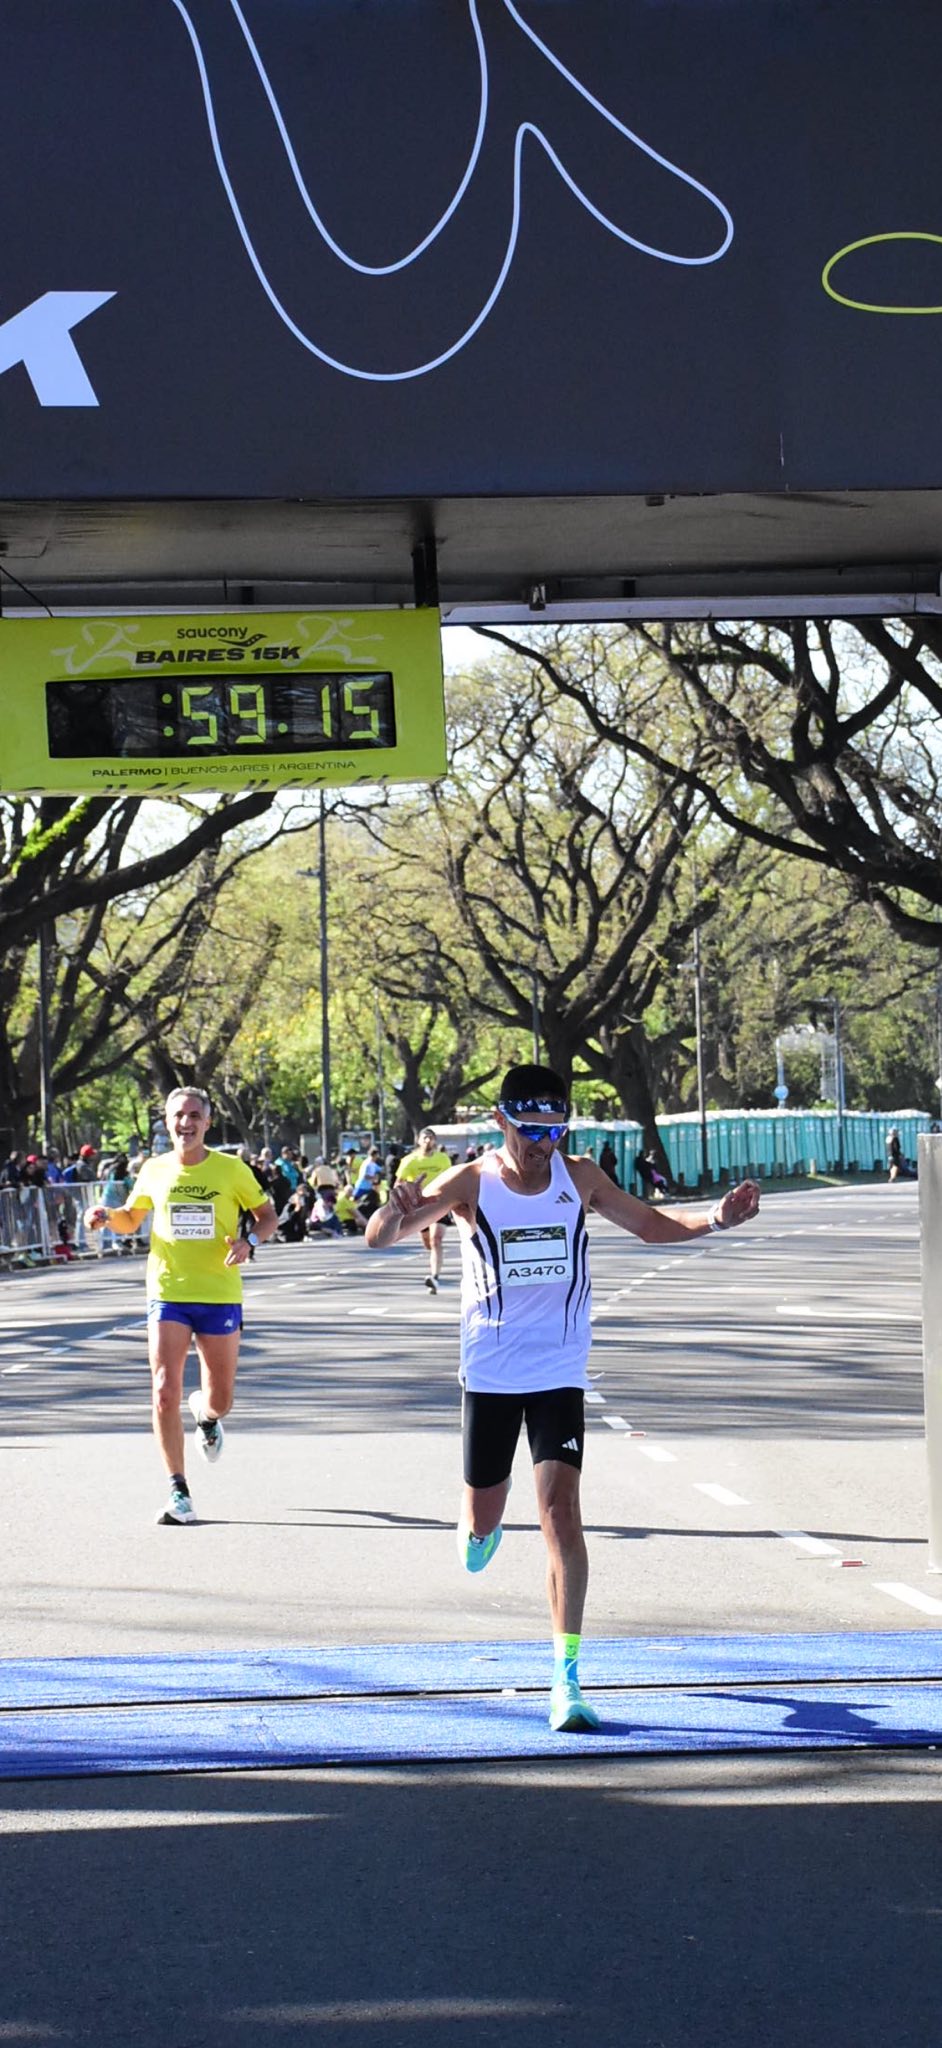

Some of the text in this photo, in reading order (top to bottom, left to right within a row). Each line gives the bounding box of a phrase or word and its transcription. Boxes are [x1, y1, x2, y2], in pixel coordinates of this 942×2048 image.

[177, 626, 248, 639] saucony
[135, 645, 302, 664] BAIRES 15K
[92, 760, 356, 777] PALERMO BUENOS AIRES ARGENTINA
[170, 1185, 207, 1194] ucony
[507, 1264, 566, 1278] A3470
